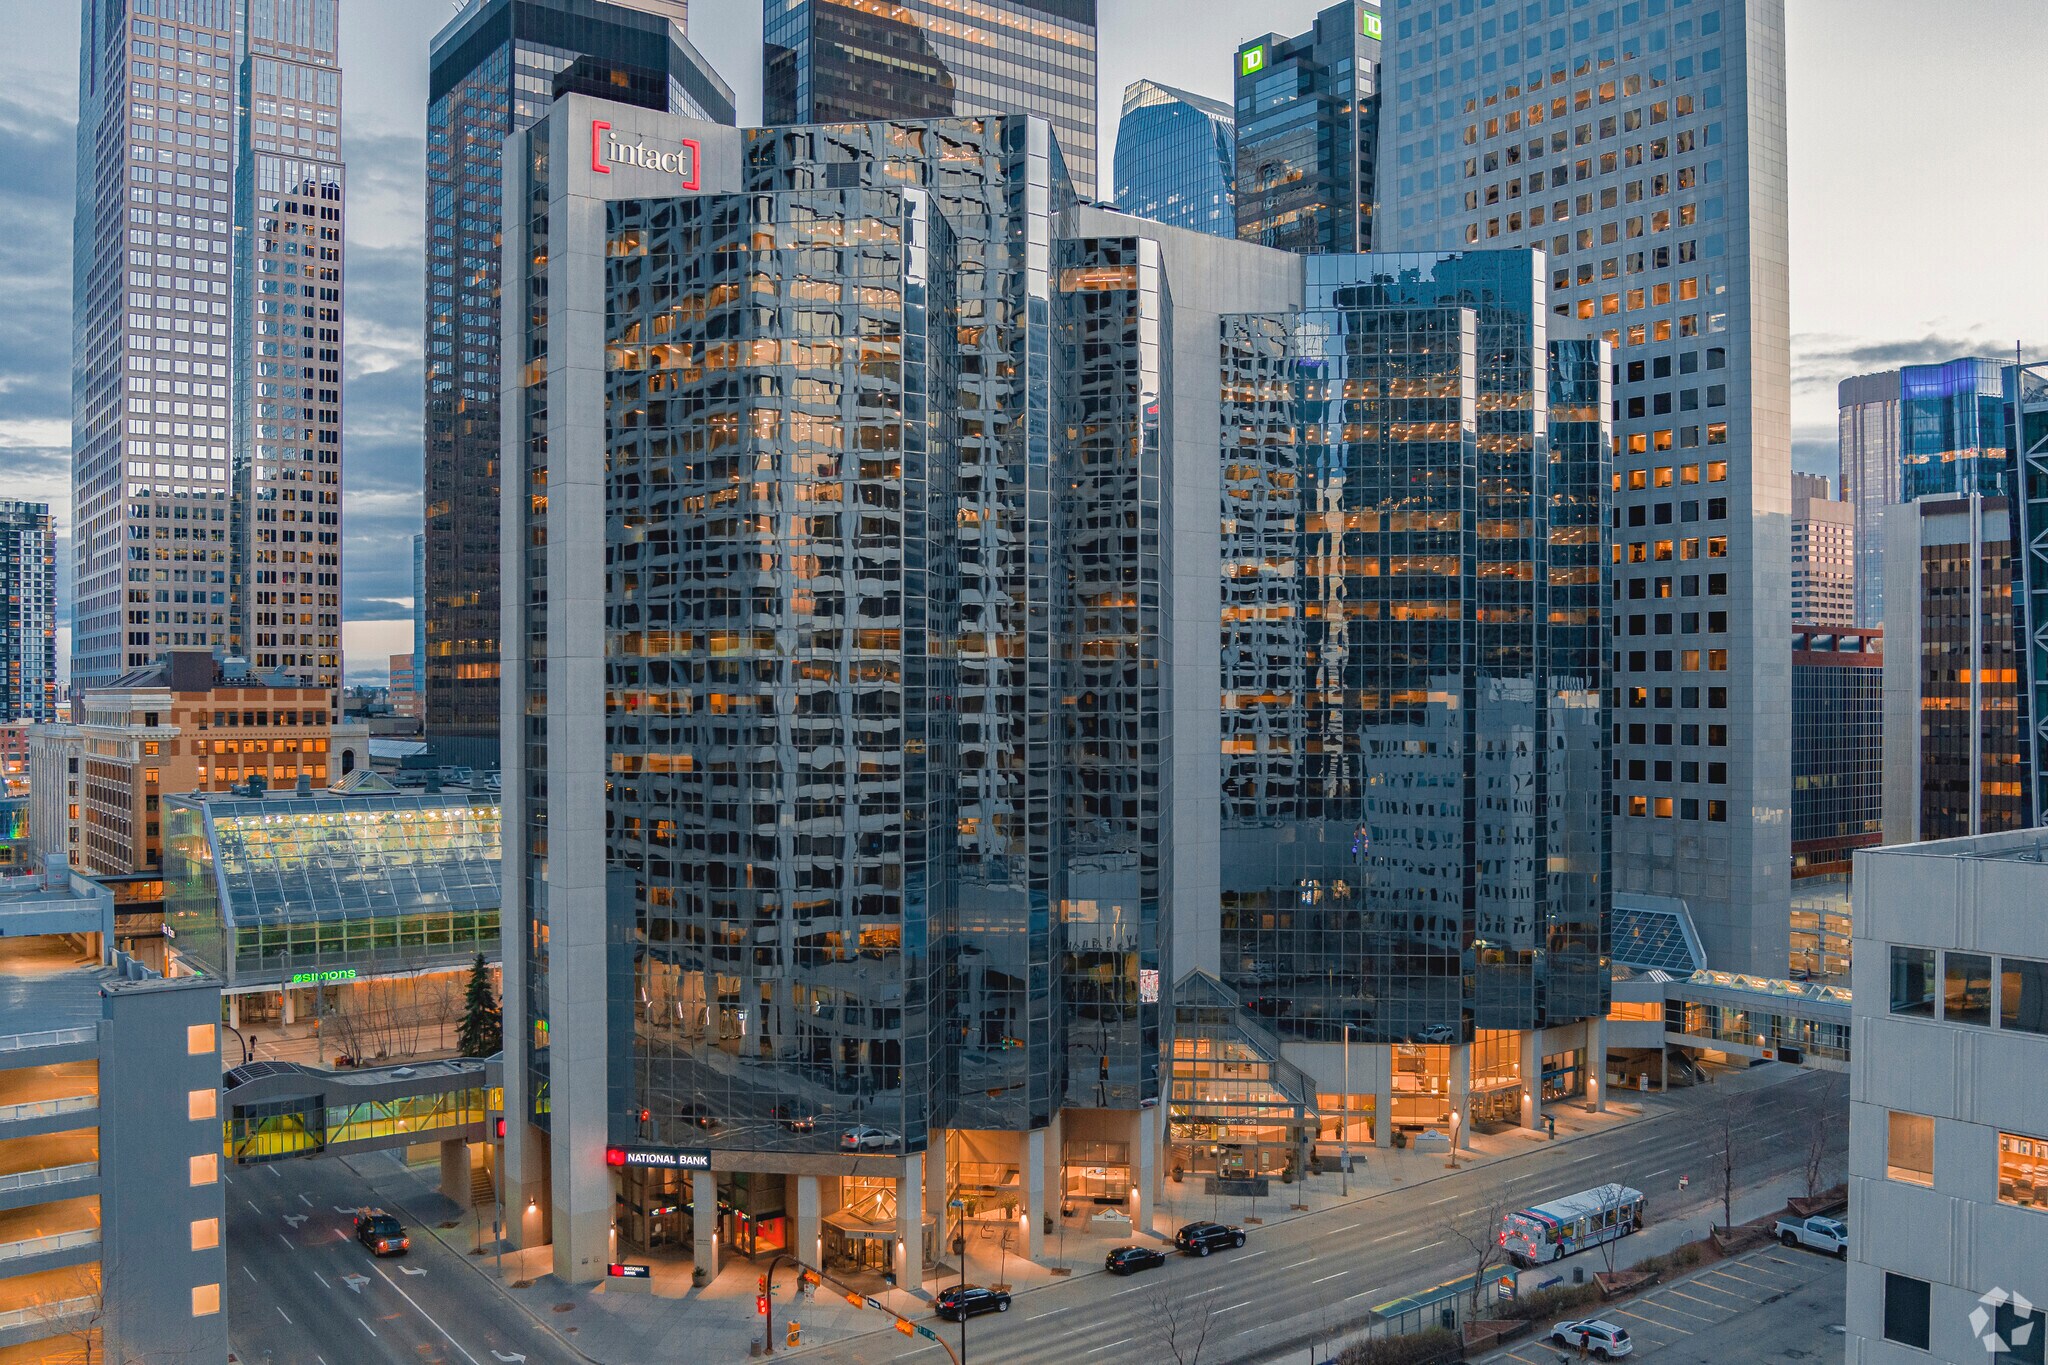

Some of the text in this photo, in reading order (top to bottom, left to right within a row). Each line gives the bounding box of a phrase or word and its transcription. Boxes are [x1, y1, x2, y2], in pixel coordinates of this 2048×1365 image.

[1365, 14, 1382, 34] TD
[1244, 50, 1261, 69] TD
[607, 132, 688, 176] intact
[302, 969, 356, 983] simons
[627, 1153, 708, 1166] NATIONAL BANK
